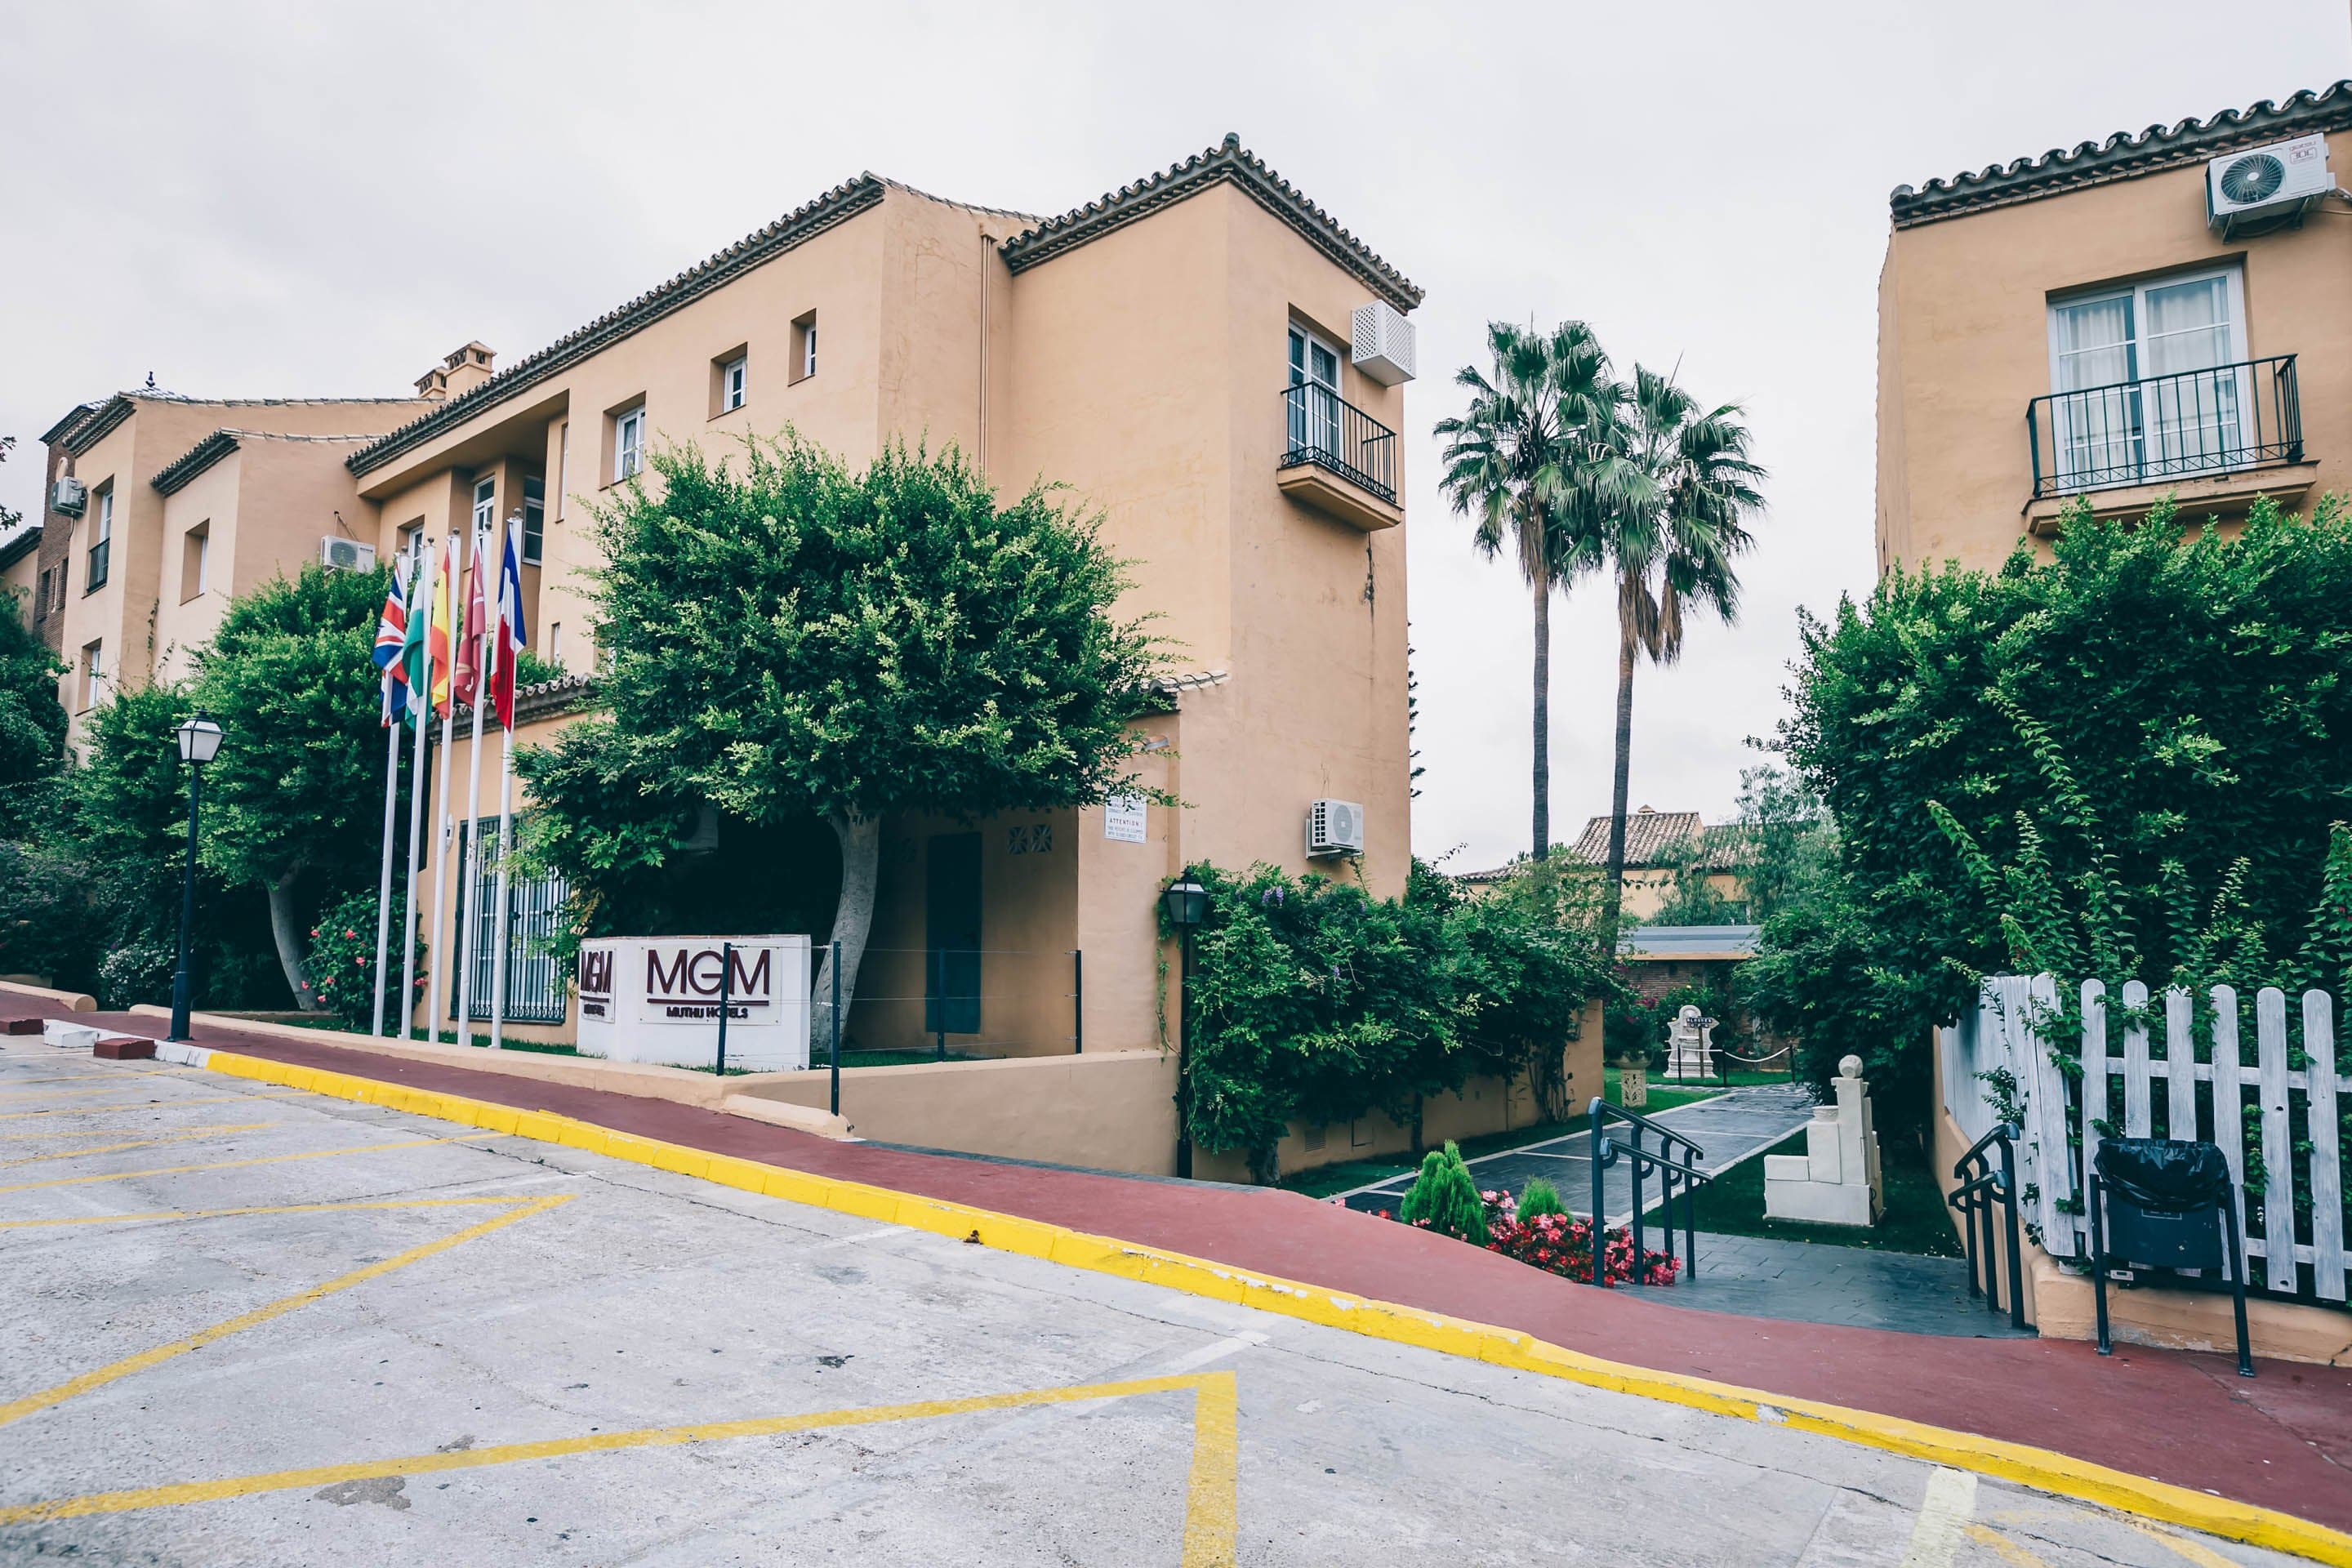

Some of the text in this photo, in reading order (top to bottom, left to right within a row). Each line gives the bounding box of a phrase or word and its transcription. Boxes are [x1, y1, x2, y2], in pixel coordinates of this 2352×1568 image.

[580, 951, 612, 994] MGM
[647, 949, 770, 996] MGM
[666, 1006, 705, 1018] MUTHU
